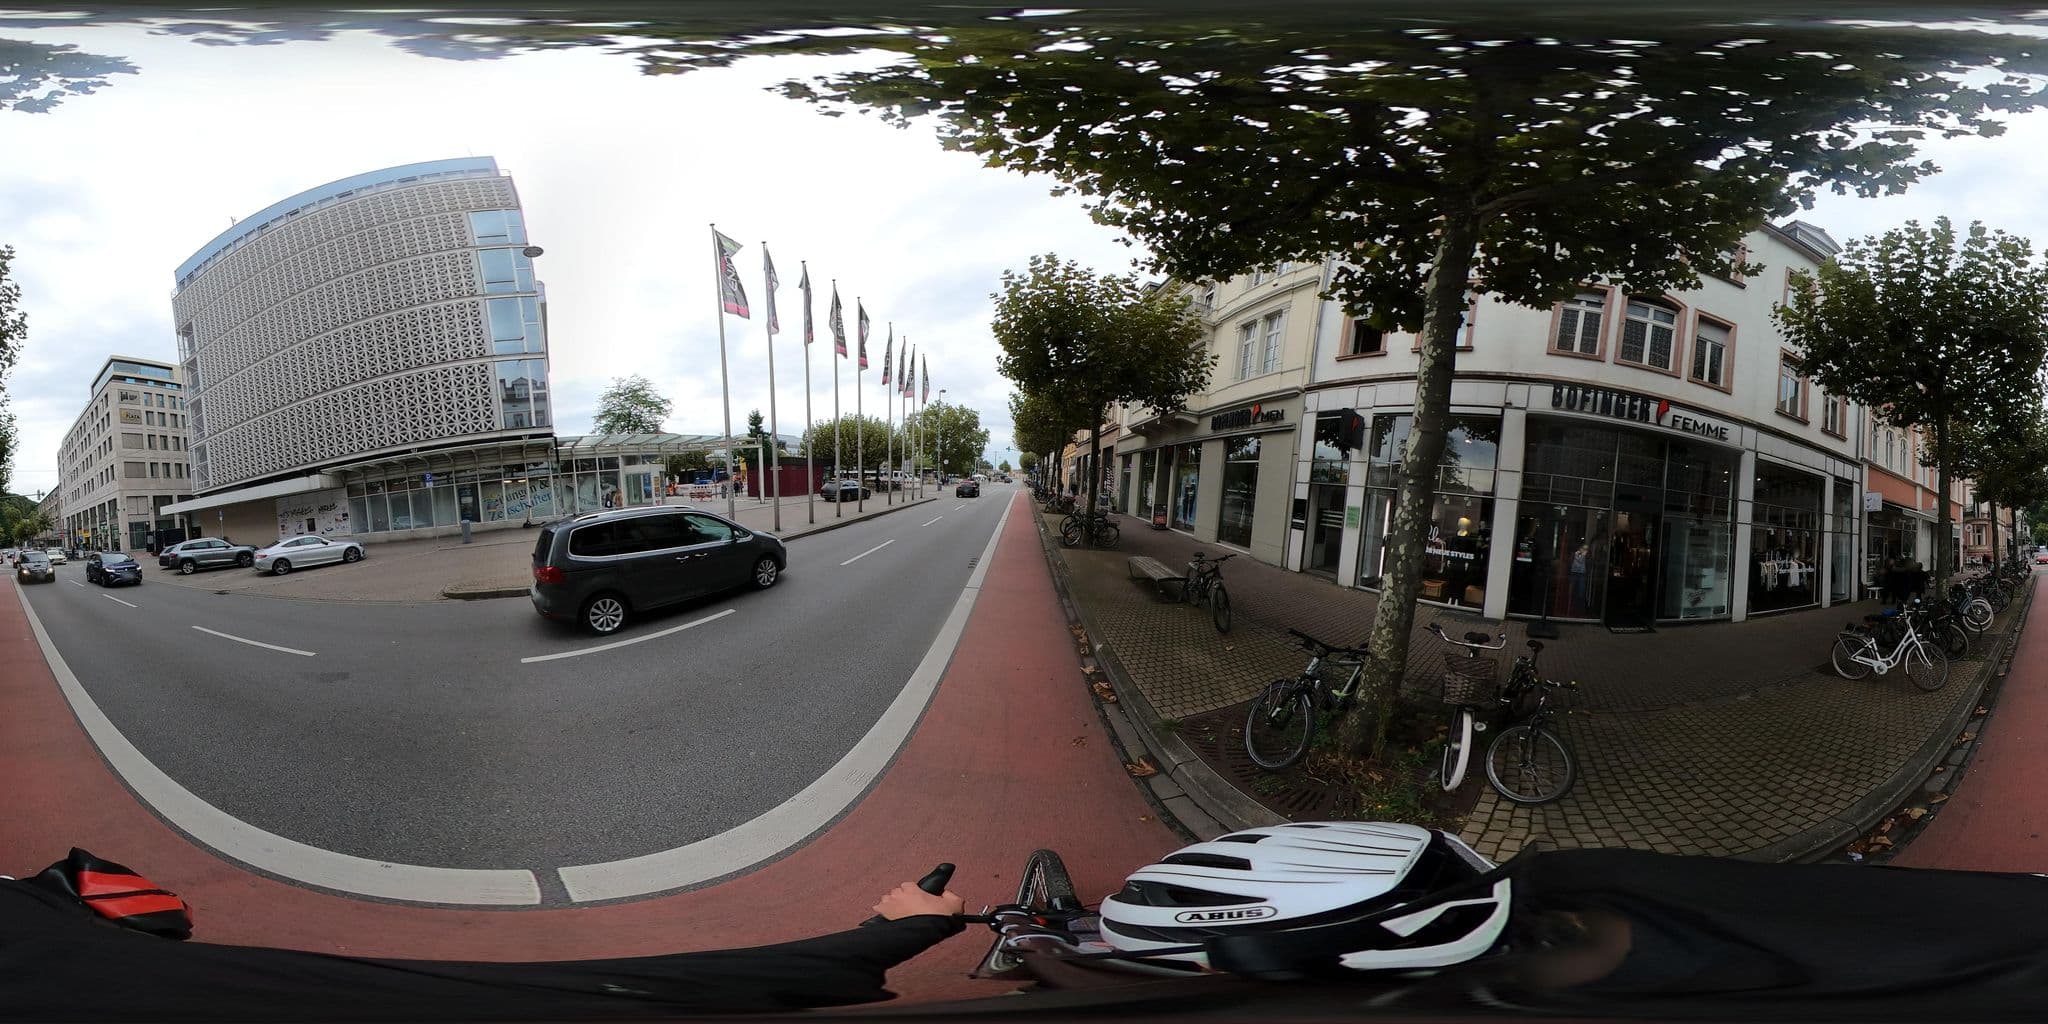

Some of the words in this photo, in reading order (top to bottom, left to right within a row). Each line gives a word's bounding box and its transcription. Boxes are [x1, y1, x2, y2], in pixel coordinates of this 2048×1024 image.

[1261, 409, 1284, 422] MEN
[1551, 384, 1651, 423] BOFINGER
[1671, 414, 1729, 440] FEMME
[1186, 909, 1264, 921] ABUS
